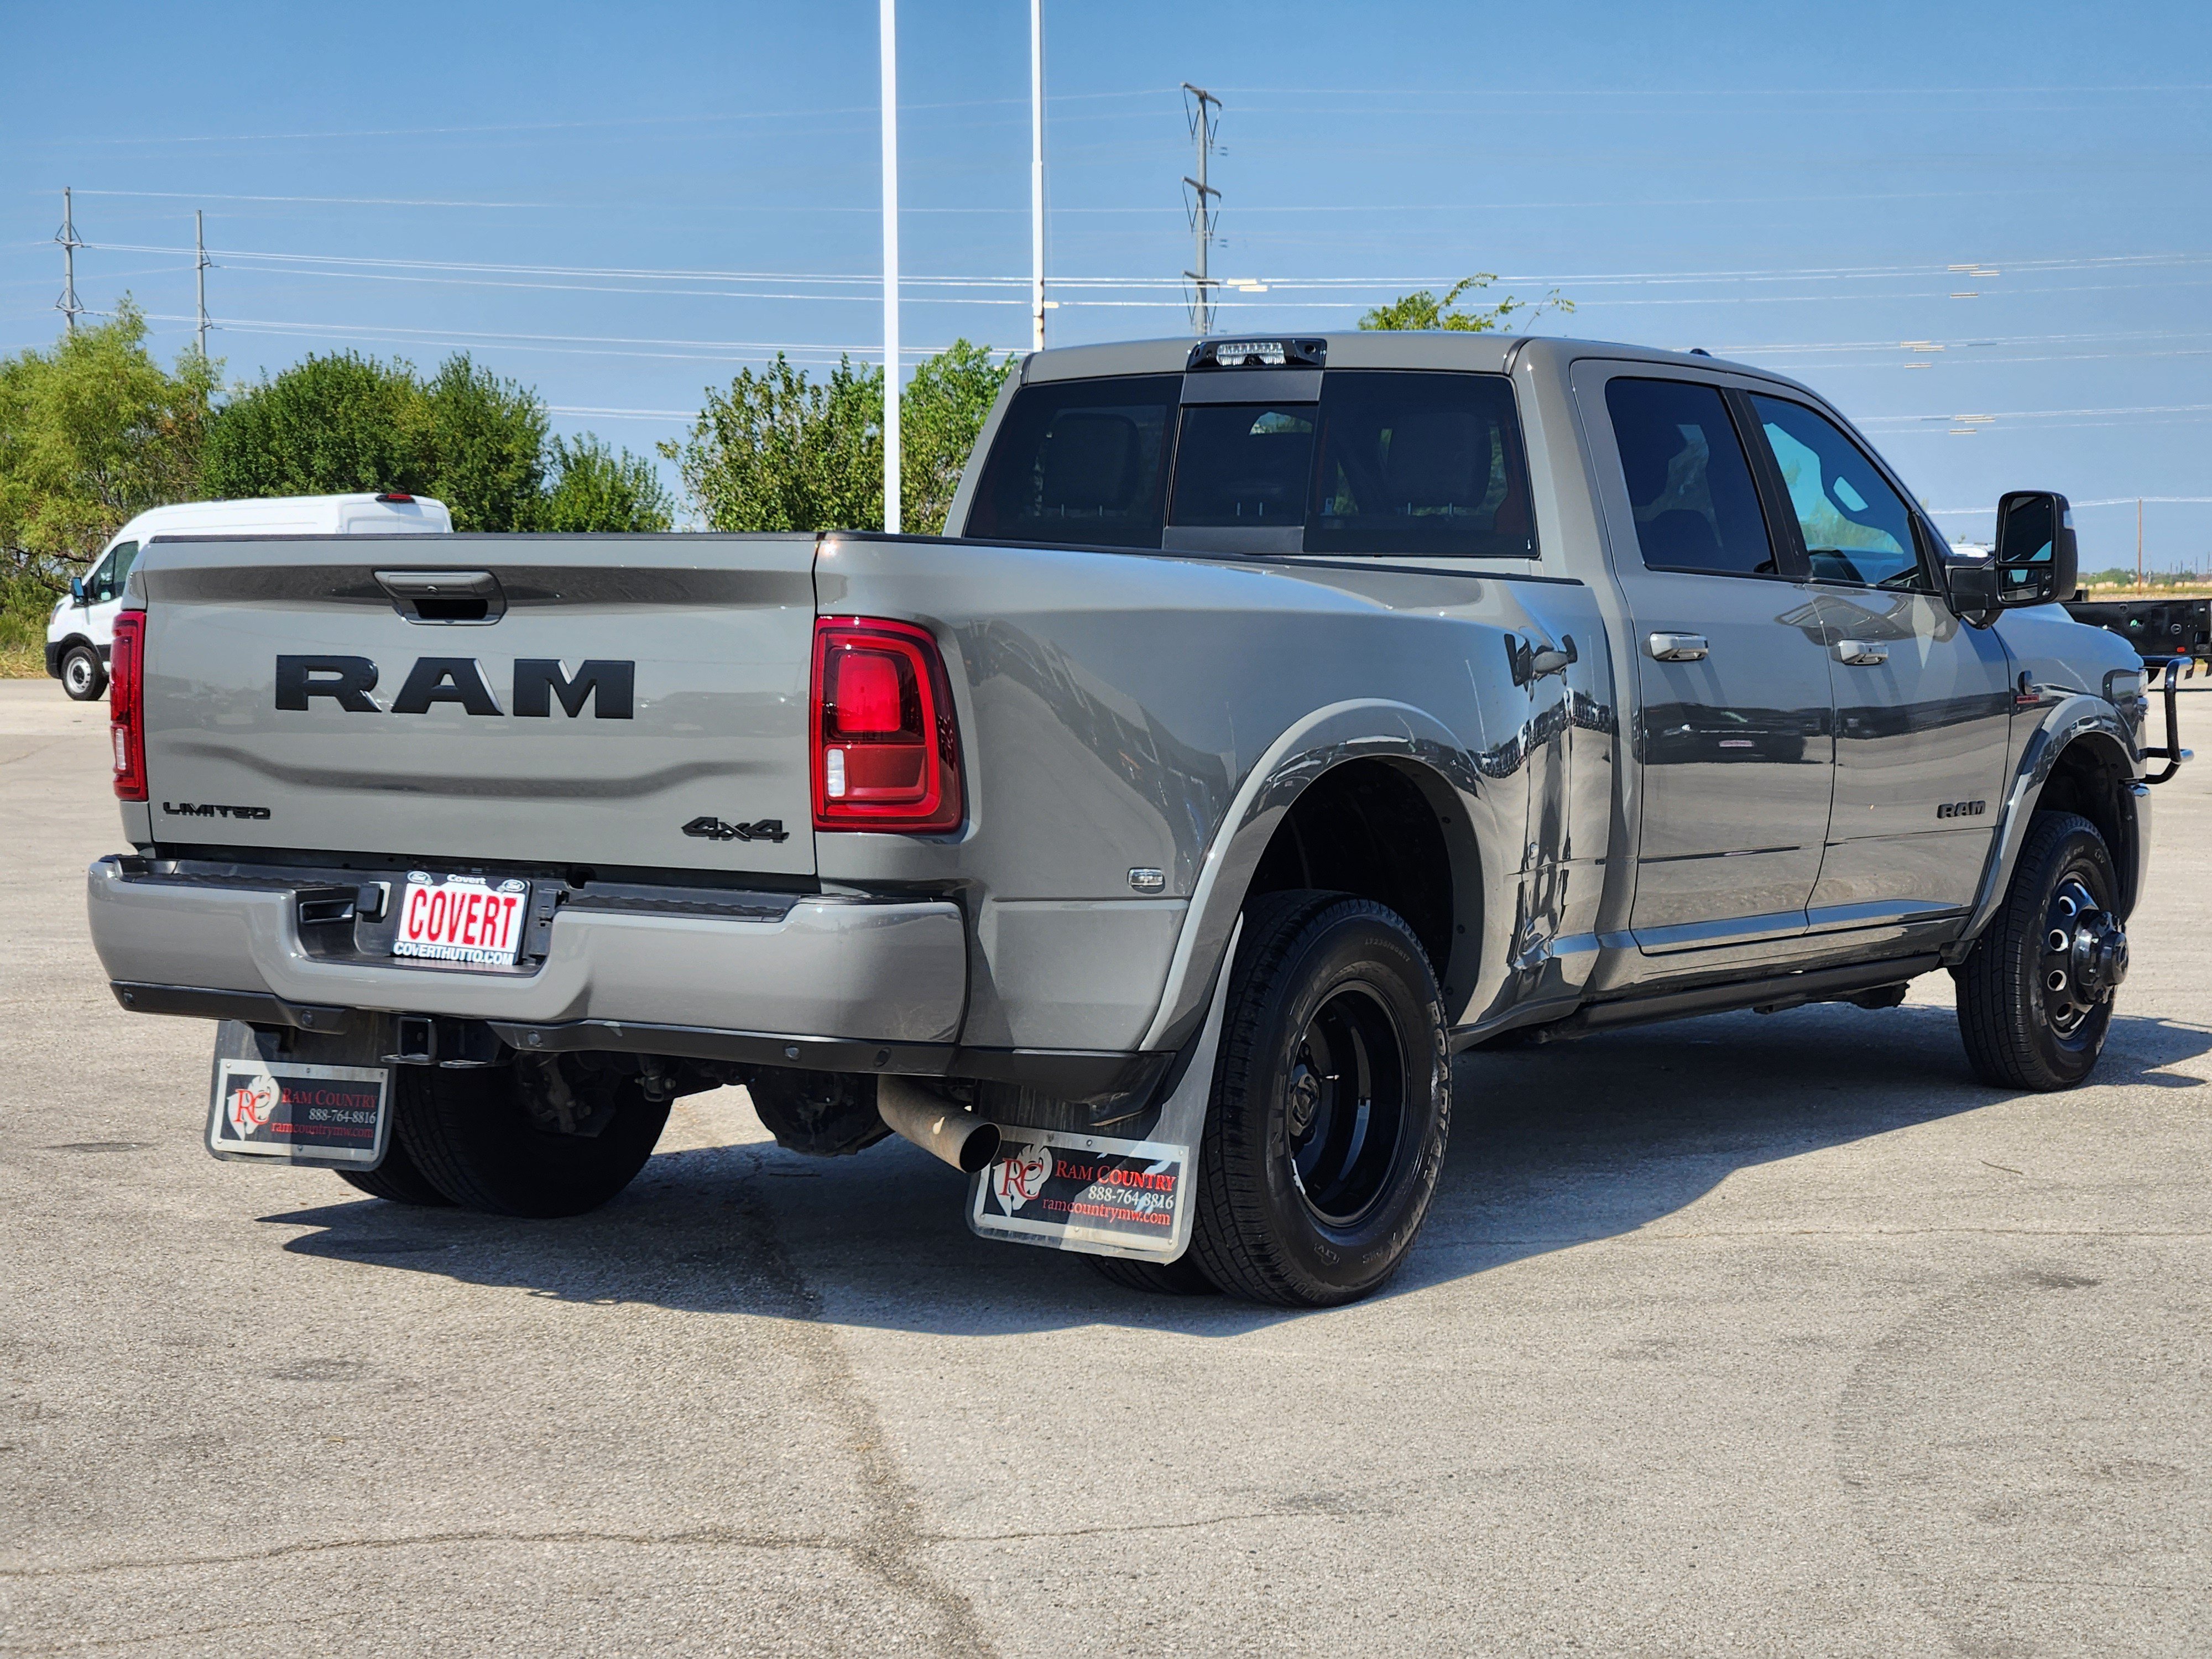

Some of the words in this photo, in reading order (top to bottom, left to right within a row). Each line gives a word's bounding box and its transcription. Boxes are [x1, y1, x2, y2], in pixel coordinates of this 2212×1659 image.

[275, 654, 635, 719] RAM
[163, 802, 270, 820] LIMITED
[1937, 800, 1986, 819] RAM
[447, 874, 486, 885] Covert
[408, 888, 517, 948] COVERT
[393, 941, 514, 965] COVERTHUTTO.COM
[309, 1108, 377, 1124] 888-764-8816
[1088, 1185, 1174, 1210] 888-7648816
[1042, 1198, 1171, 1225] ramcountrymw.com
